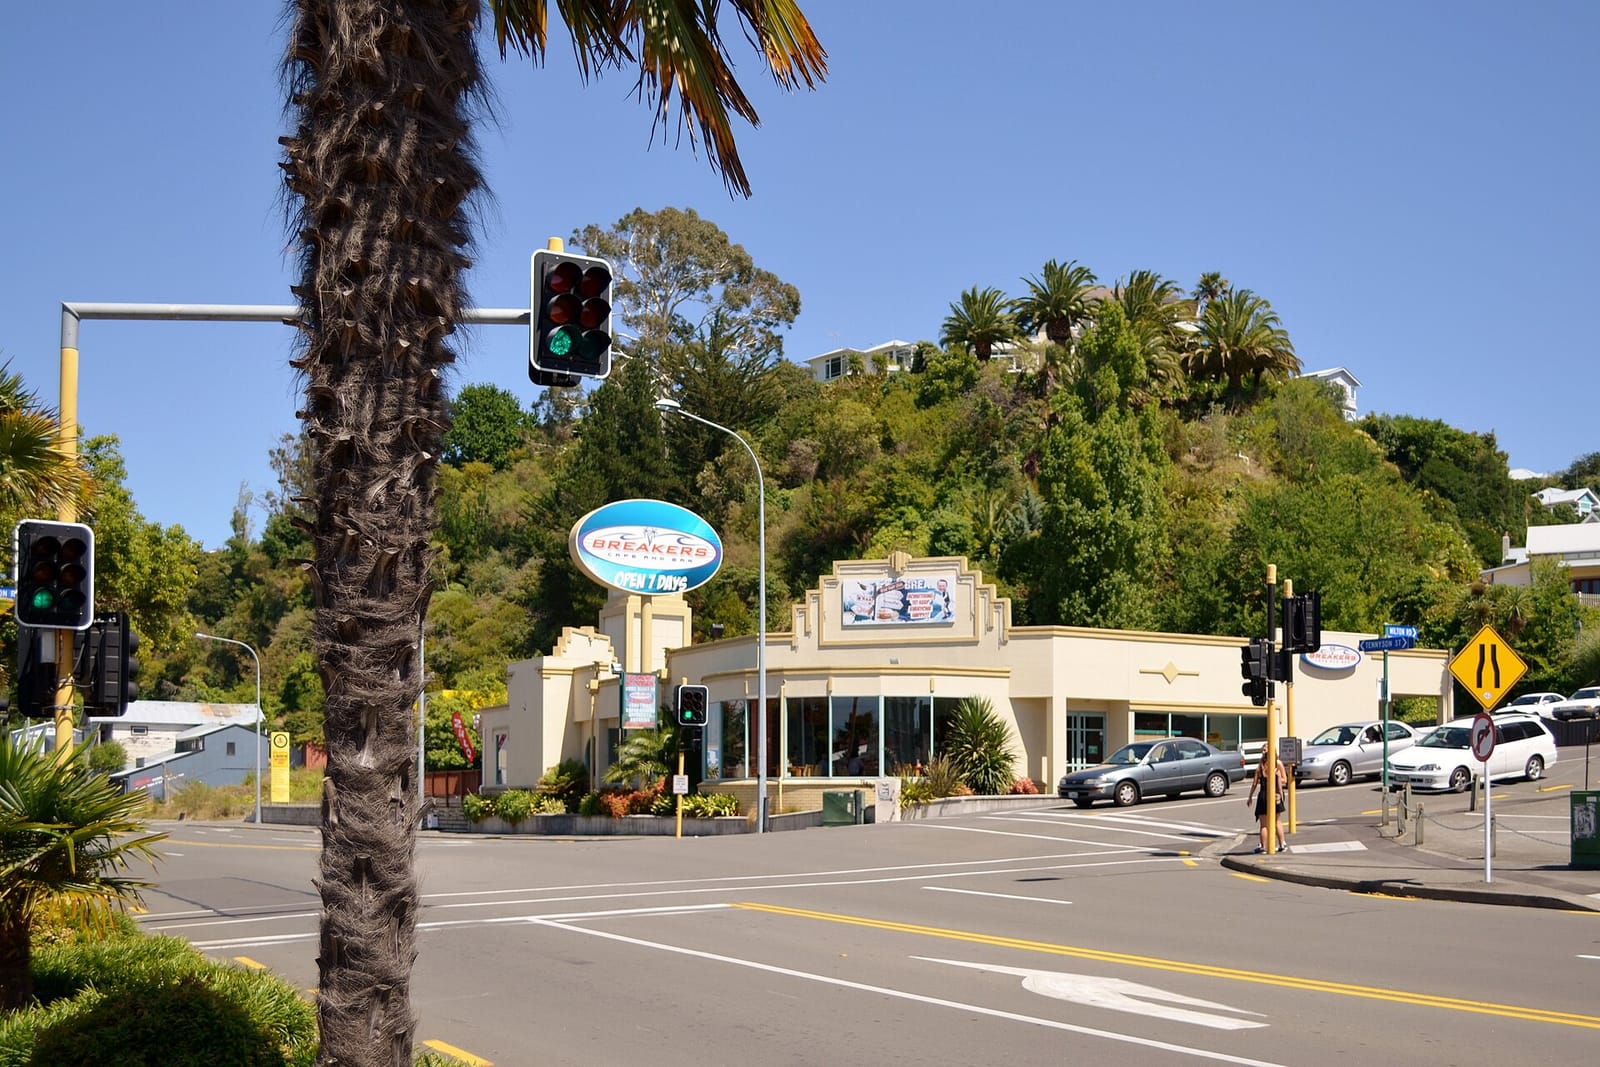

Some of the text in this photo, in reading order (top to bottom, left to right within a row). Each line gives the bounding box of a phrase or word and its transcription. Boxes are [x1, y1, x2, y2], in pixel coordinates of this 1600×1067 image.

[592, 539, 708, 557] BREAKERS
[614, 571, 688, 592] OPEN 7 DAYS
[1389, 626, 1405, 636] MILTON
[1365, 638, 1402, 649] TENNYSON ST
